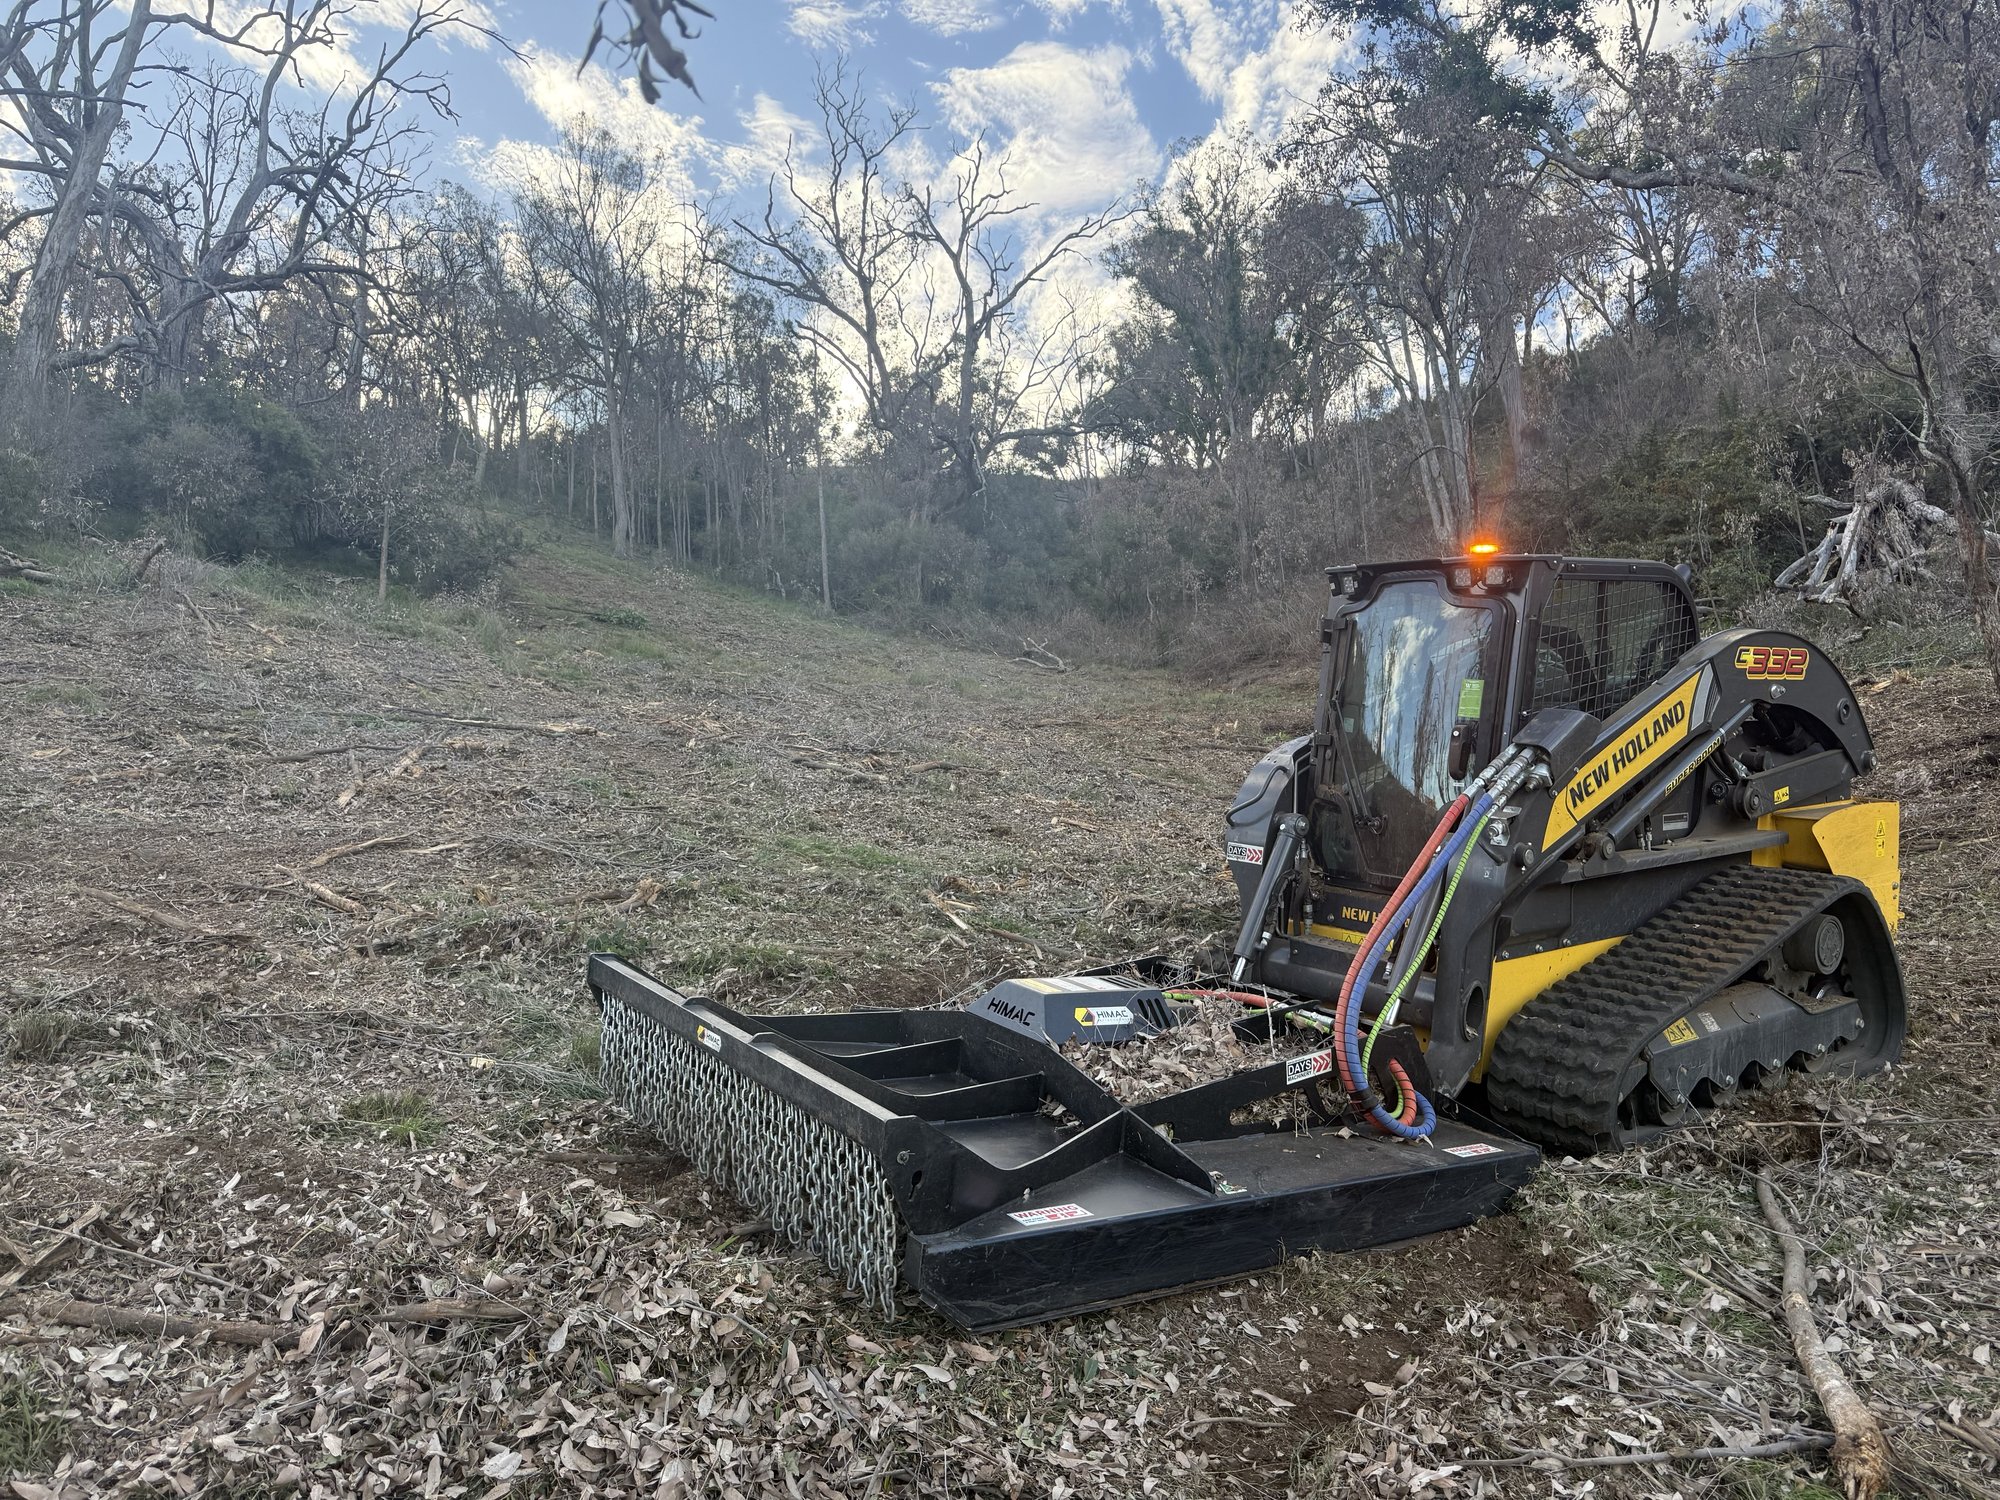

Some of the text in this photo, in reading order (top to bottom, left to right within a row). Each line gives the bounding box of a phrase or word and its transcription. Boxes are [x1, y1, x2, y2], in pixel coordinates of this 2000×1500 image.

[1568, 700, 1686, 809] NEW HOLLAND
[1665, 736, 1722, 795] SUPER BOOM
[1228, 845, 1247, 856] DAYS
[1341, 906, 1370, 923] NEW
[987, 997, 1036, 1027] HIMAC
[1096, 1010, 1129, 1019] HIMAC
[1288, 1059, 1312, 1076] DAYS
[1013, 1205, 1079, 1219] WARNING
